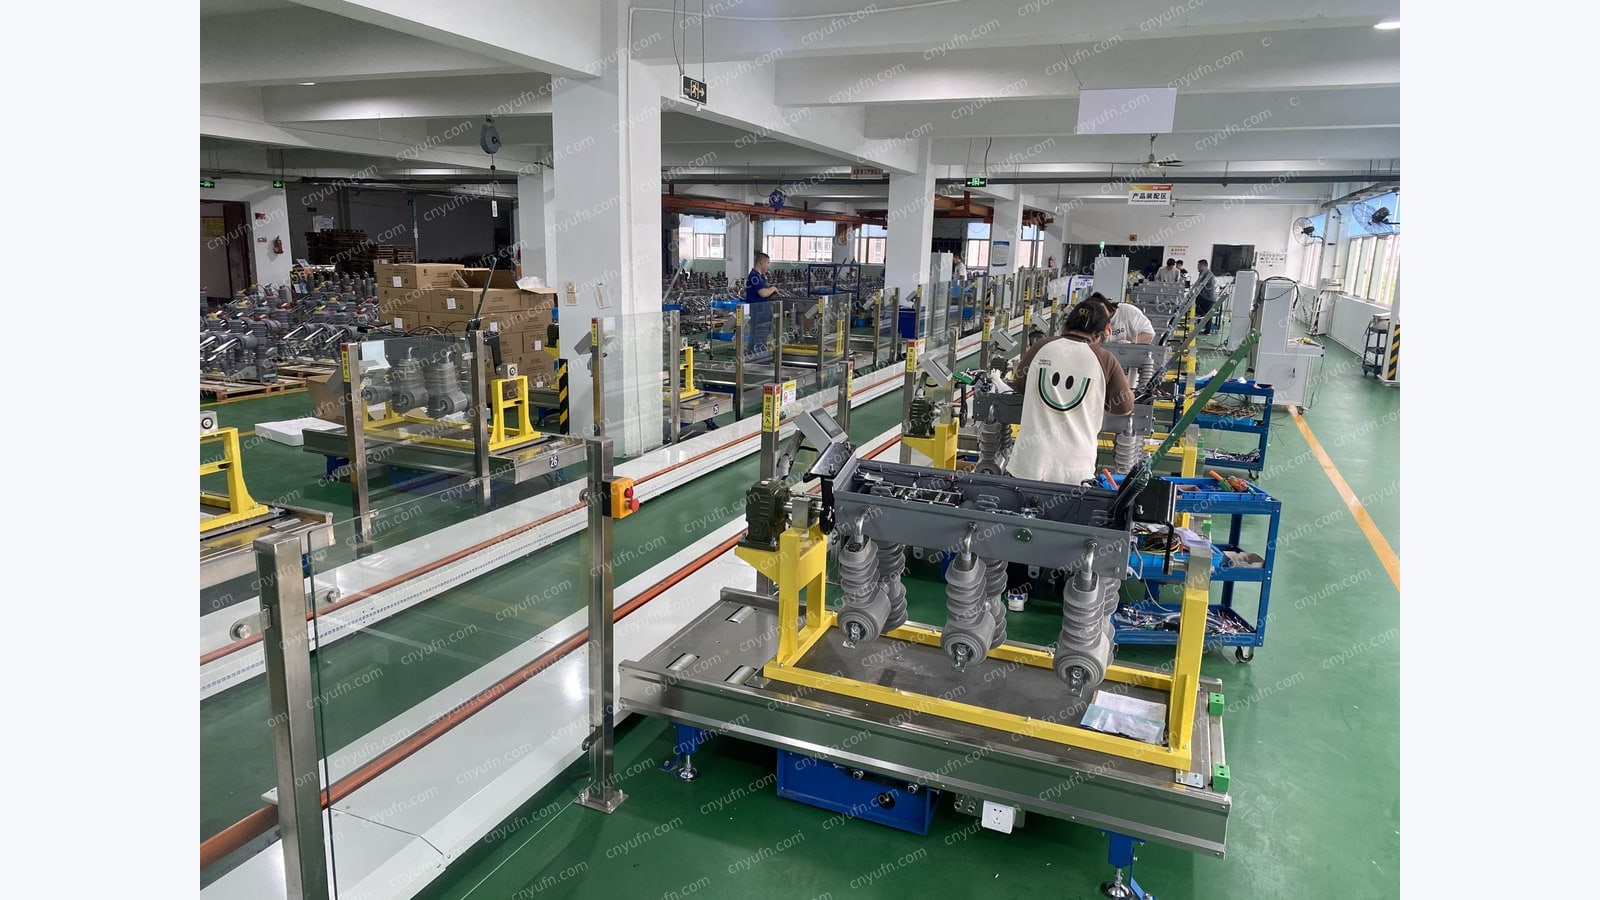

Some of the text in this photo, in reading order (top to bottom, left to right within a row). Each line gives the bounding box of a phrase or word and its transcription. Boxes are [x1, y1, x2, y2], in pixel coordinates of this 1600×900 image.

[1132, 192, 1167, 200] 产品装配区
[550, 456, 558, 467] 26
